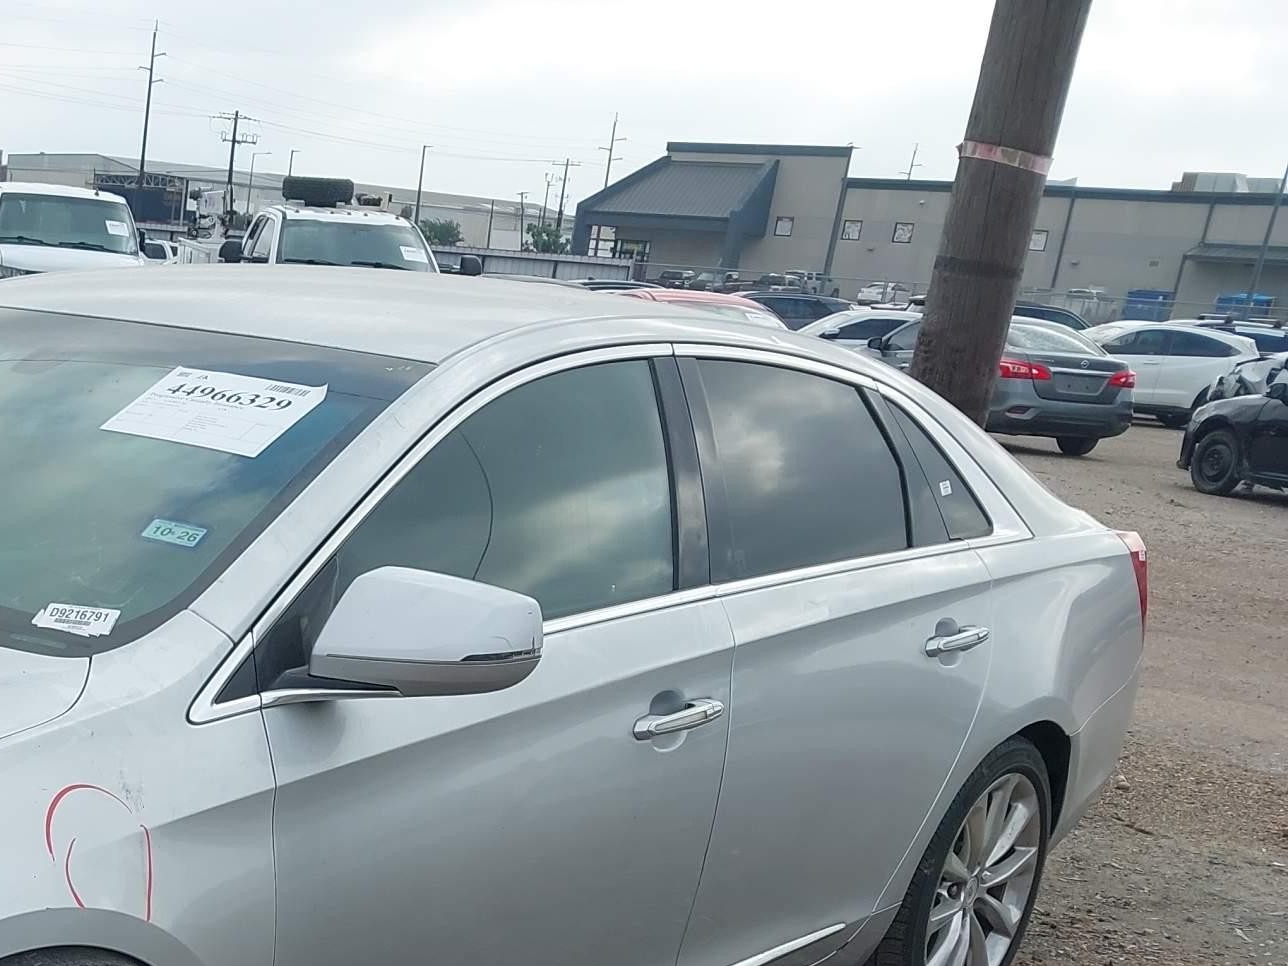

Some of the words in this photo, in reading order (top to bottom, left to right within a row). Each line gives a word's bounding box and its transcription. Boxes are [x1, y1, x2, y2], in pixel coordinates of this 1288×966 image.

[167, 383, 293, 410] 44966329
[152, 524, 173, 537] 10
[176, 530, 200, 542] 26
[49, 607, 110, 623] D9216791
